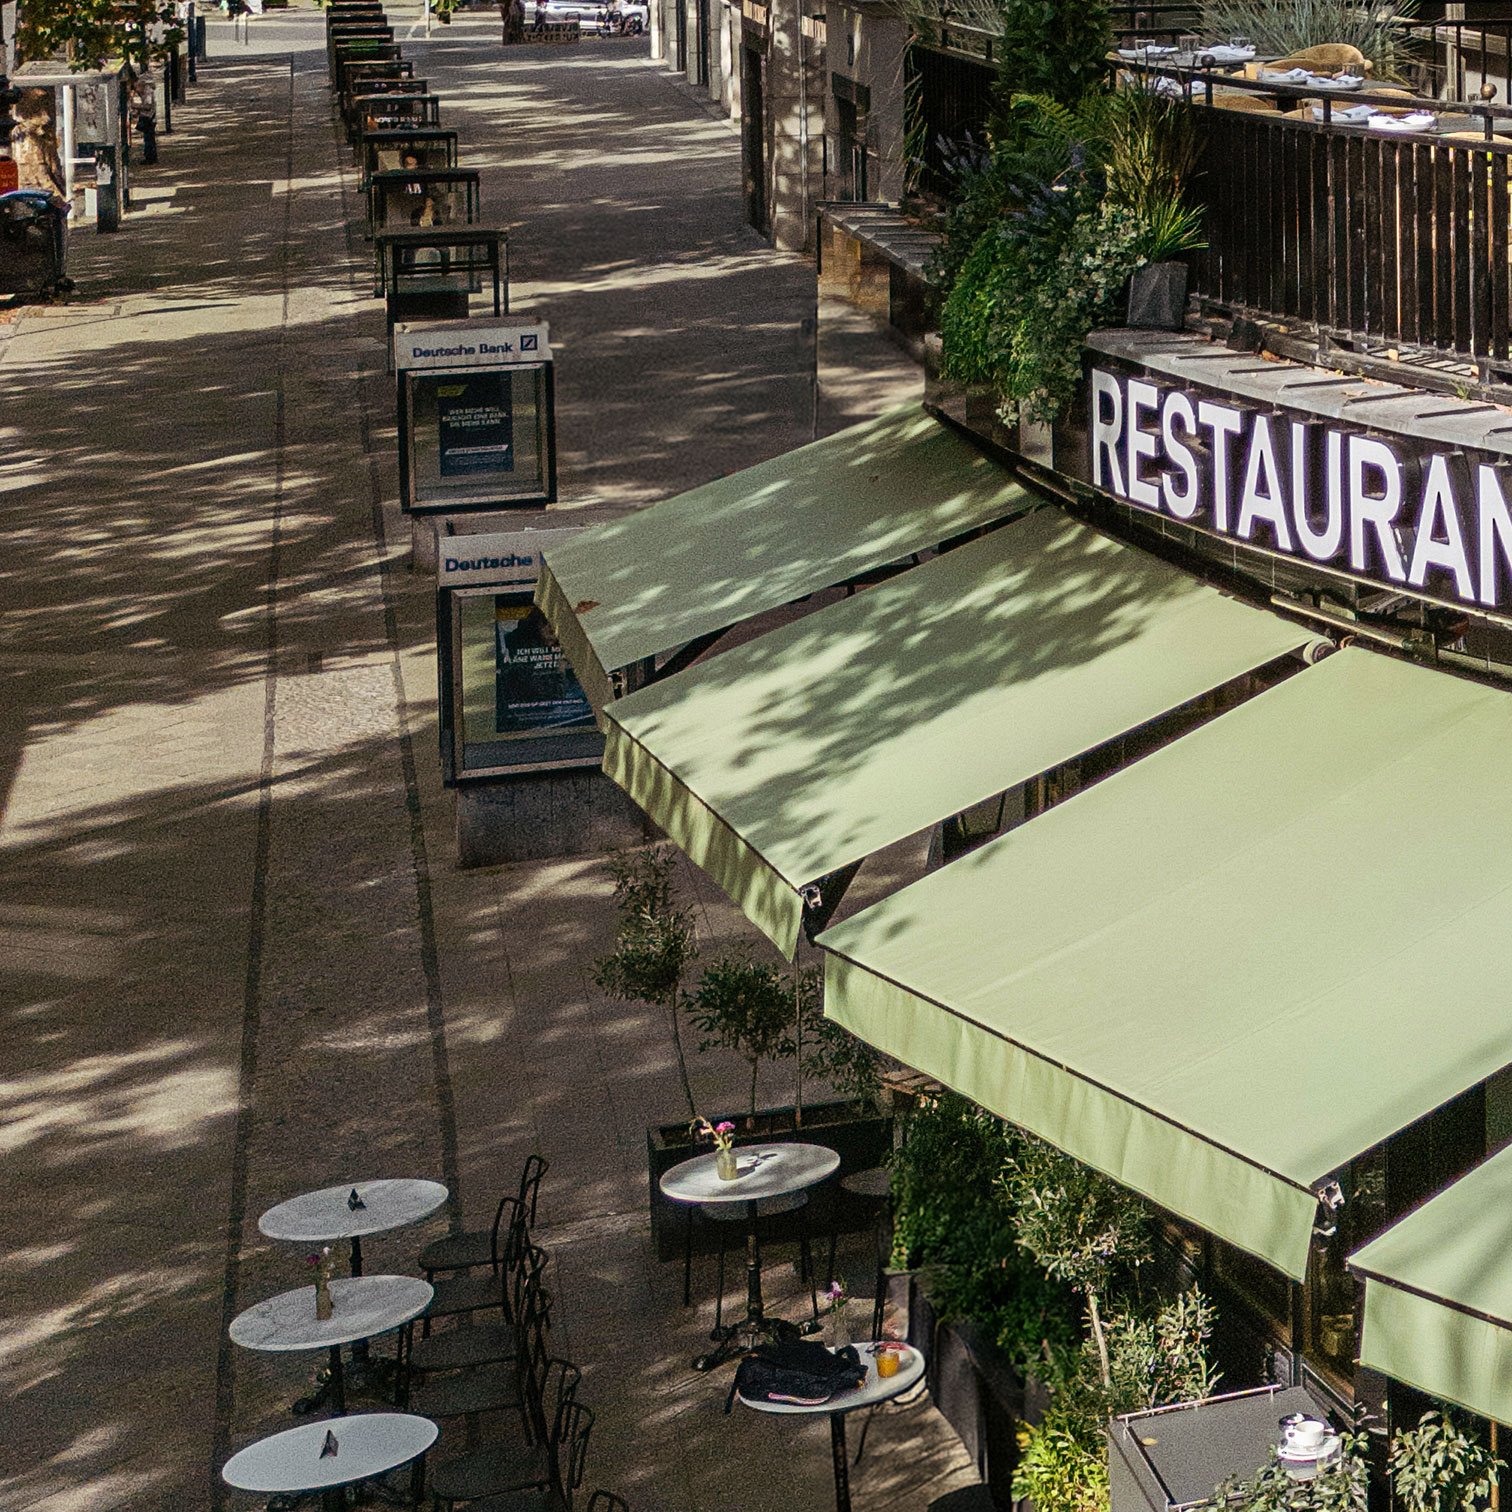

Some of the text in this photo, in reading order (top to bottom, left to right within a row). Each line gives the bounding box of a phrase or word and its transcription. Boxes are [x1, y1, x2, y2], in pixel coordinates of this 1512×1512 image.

[413, 342, 513, 358] Deutsche Bank
[445, 554, 533, 572] Deutsche
